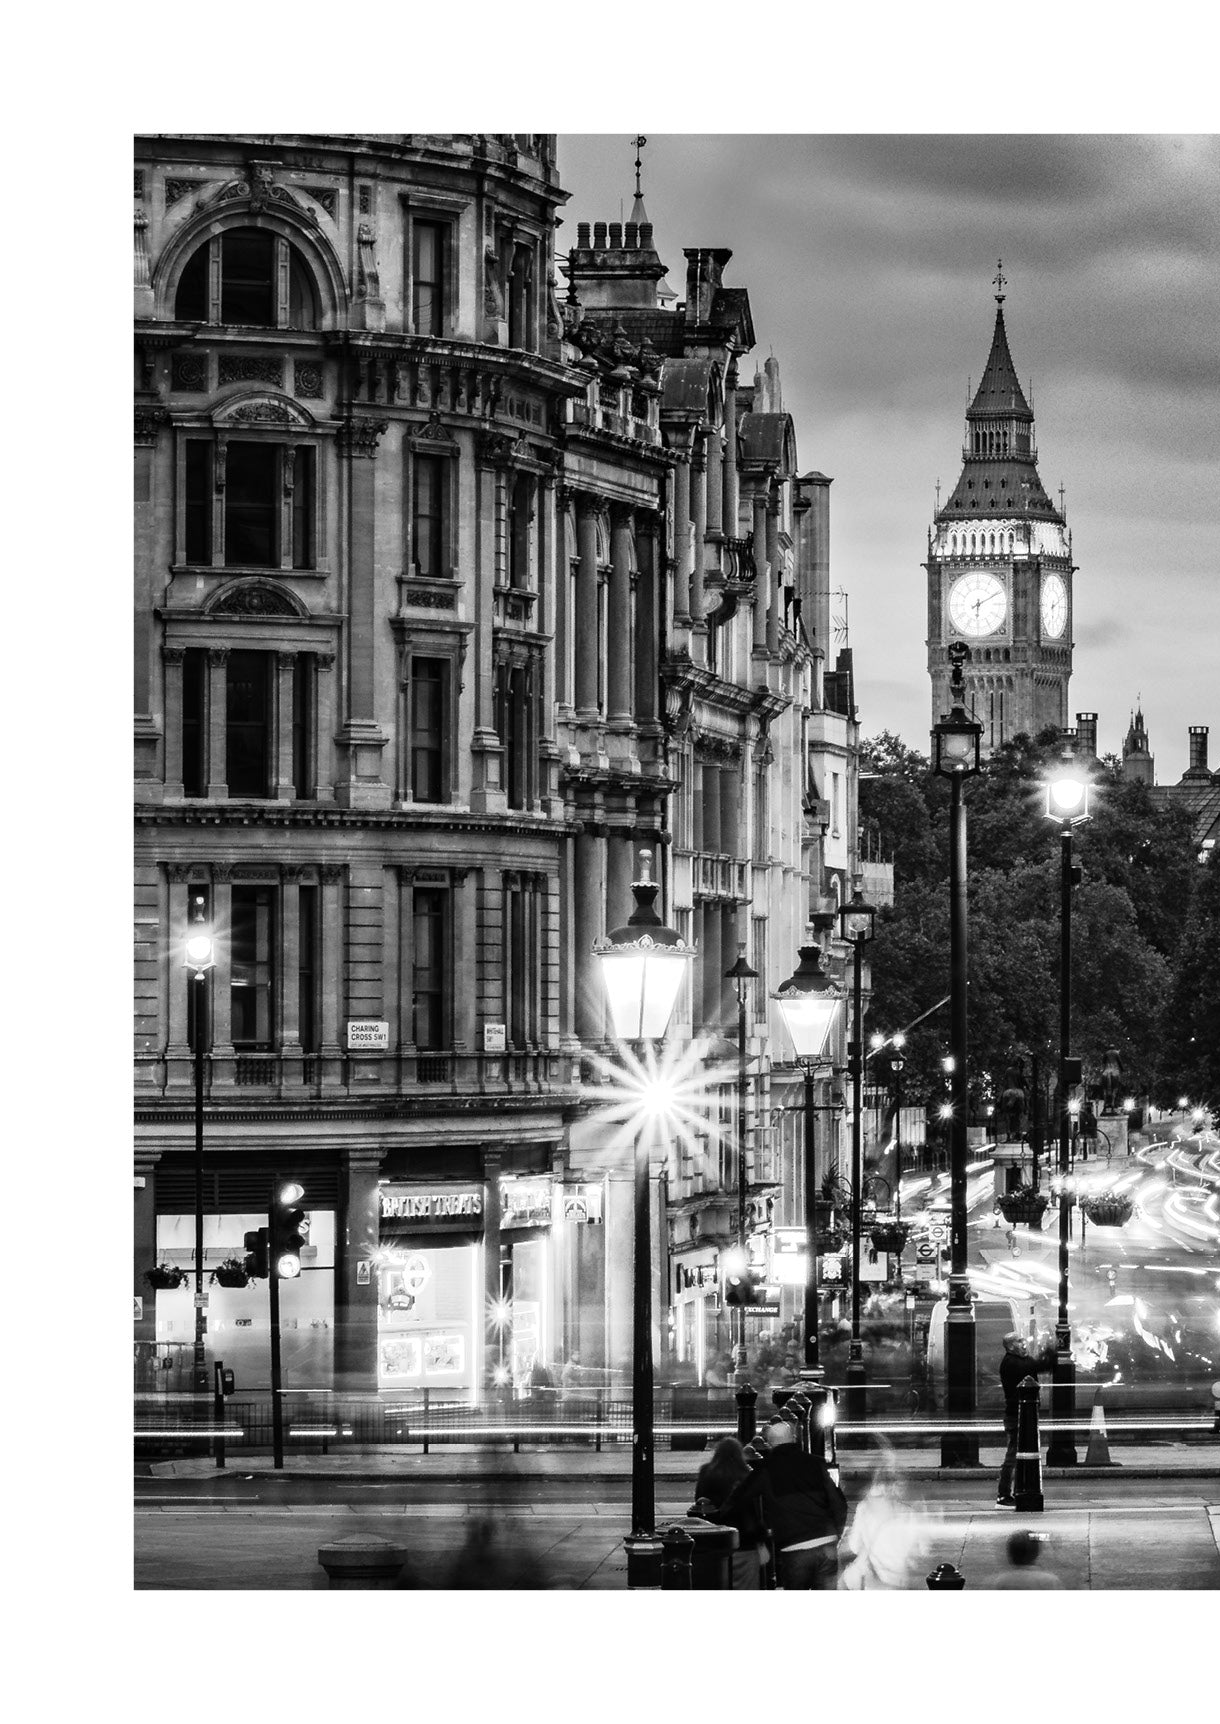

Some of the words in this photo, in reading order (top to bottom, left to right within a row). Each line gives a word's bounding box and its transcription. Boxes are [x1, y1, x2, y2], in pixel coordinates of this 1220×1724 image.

[351, 1024, 379, 1032] CHARING
[351, 1033, 372, 1041] CROSS
[373, 1033, 387, 1041] SW1
[381, 1194, 430, 1218] BRITISH
[434, 1193, 482, 1216] TREATS
